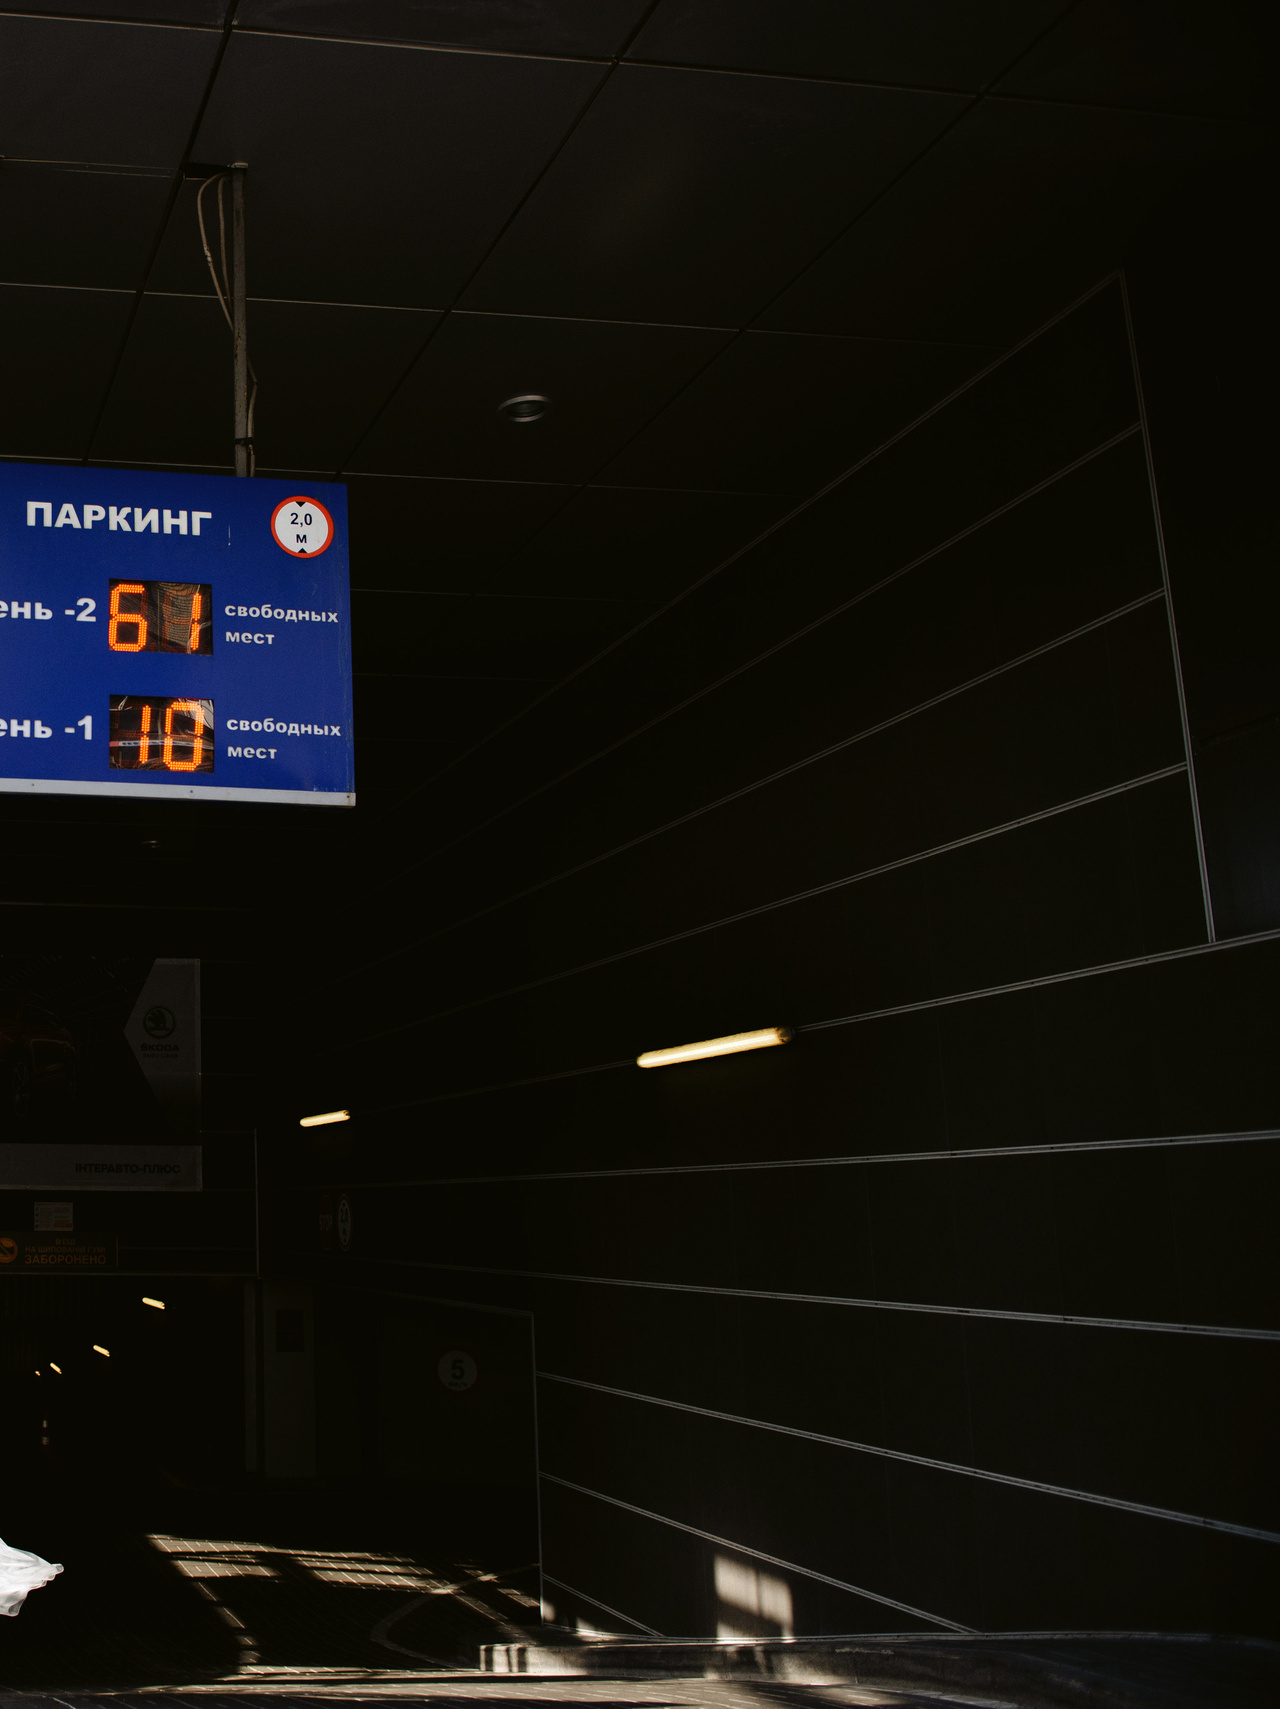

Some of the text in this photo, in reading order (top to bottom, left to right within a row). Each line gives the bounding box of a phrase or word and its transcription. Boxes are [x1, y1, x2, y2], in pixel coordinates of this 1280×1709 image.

[26, 500, 212, 536] ПАРКИНГ
[290, 512, 313, 528] 2,0
[64, 597, 97, 622] -2
[108, 584, 202, 652] 61
[224, 604, 339, 623] свободных
[225, 631, 275, 645] мест
[64, 715, 93, 740] -1
[138, 701, 205, 771] 10
[226, 717, 342, 737] свободных
[227, 746, 278, 760] мест
[140, 1042, 180, 1052] ŠKODA
[75, 1163, 181, 1174] ІНТЕРАВТО-ПЛЮС
[24, 1245, 36, 1253] НА
[24, 1254, 107, 1265] ЗАБОРОНЕНО
[450, 1359, 465, 1380] 5
